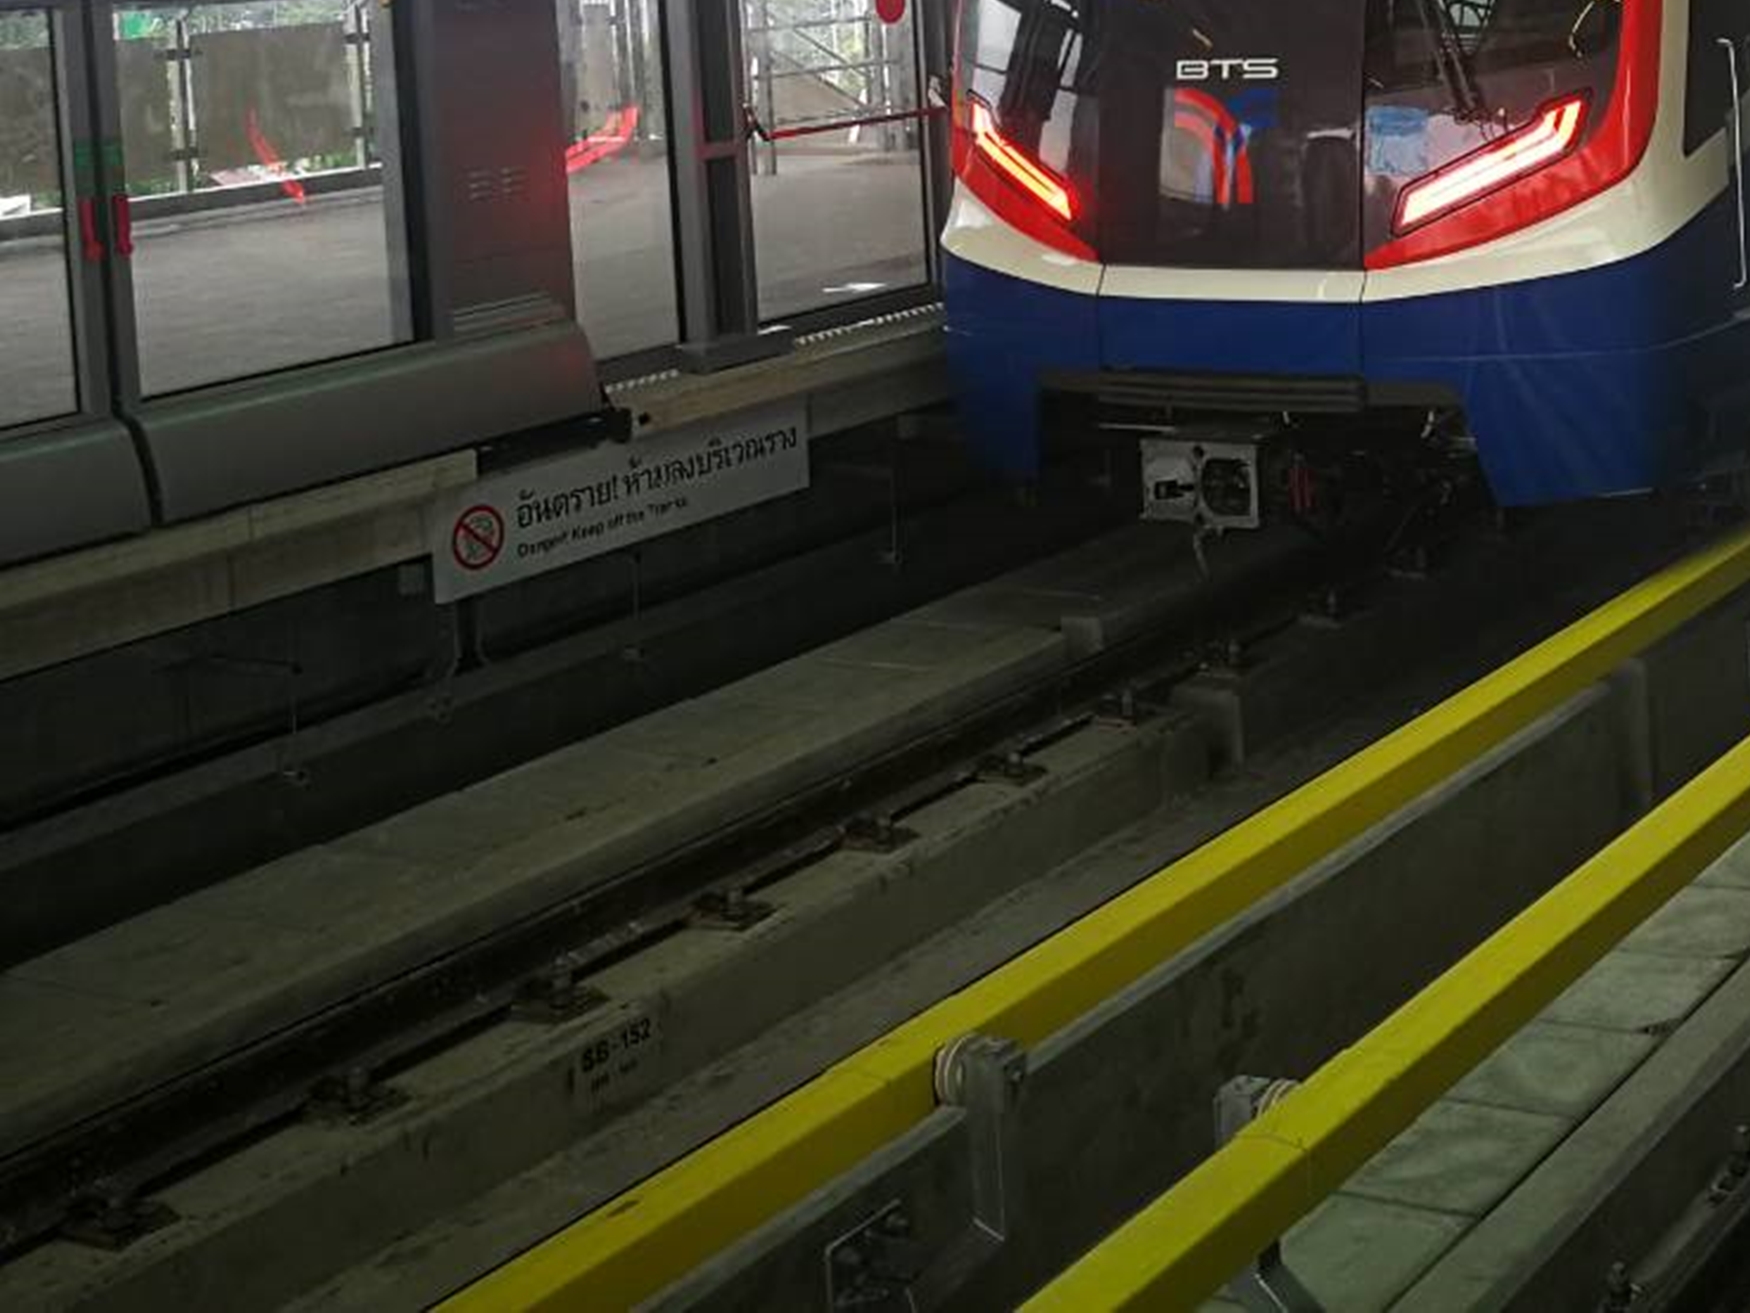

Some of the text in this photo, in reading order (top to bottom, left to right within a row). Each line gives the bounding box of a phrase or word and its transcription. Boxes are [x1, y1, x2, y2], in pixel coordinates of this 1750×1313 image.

[1175, 57, 1280, 80] BTS
[516, 426, 798, 529] อันตราย! ห้ามลงบริเวณราง
